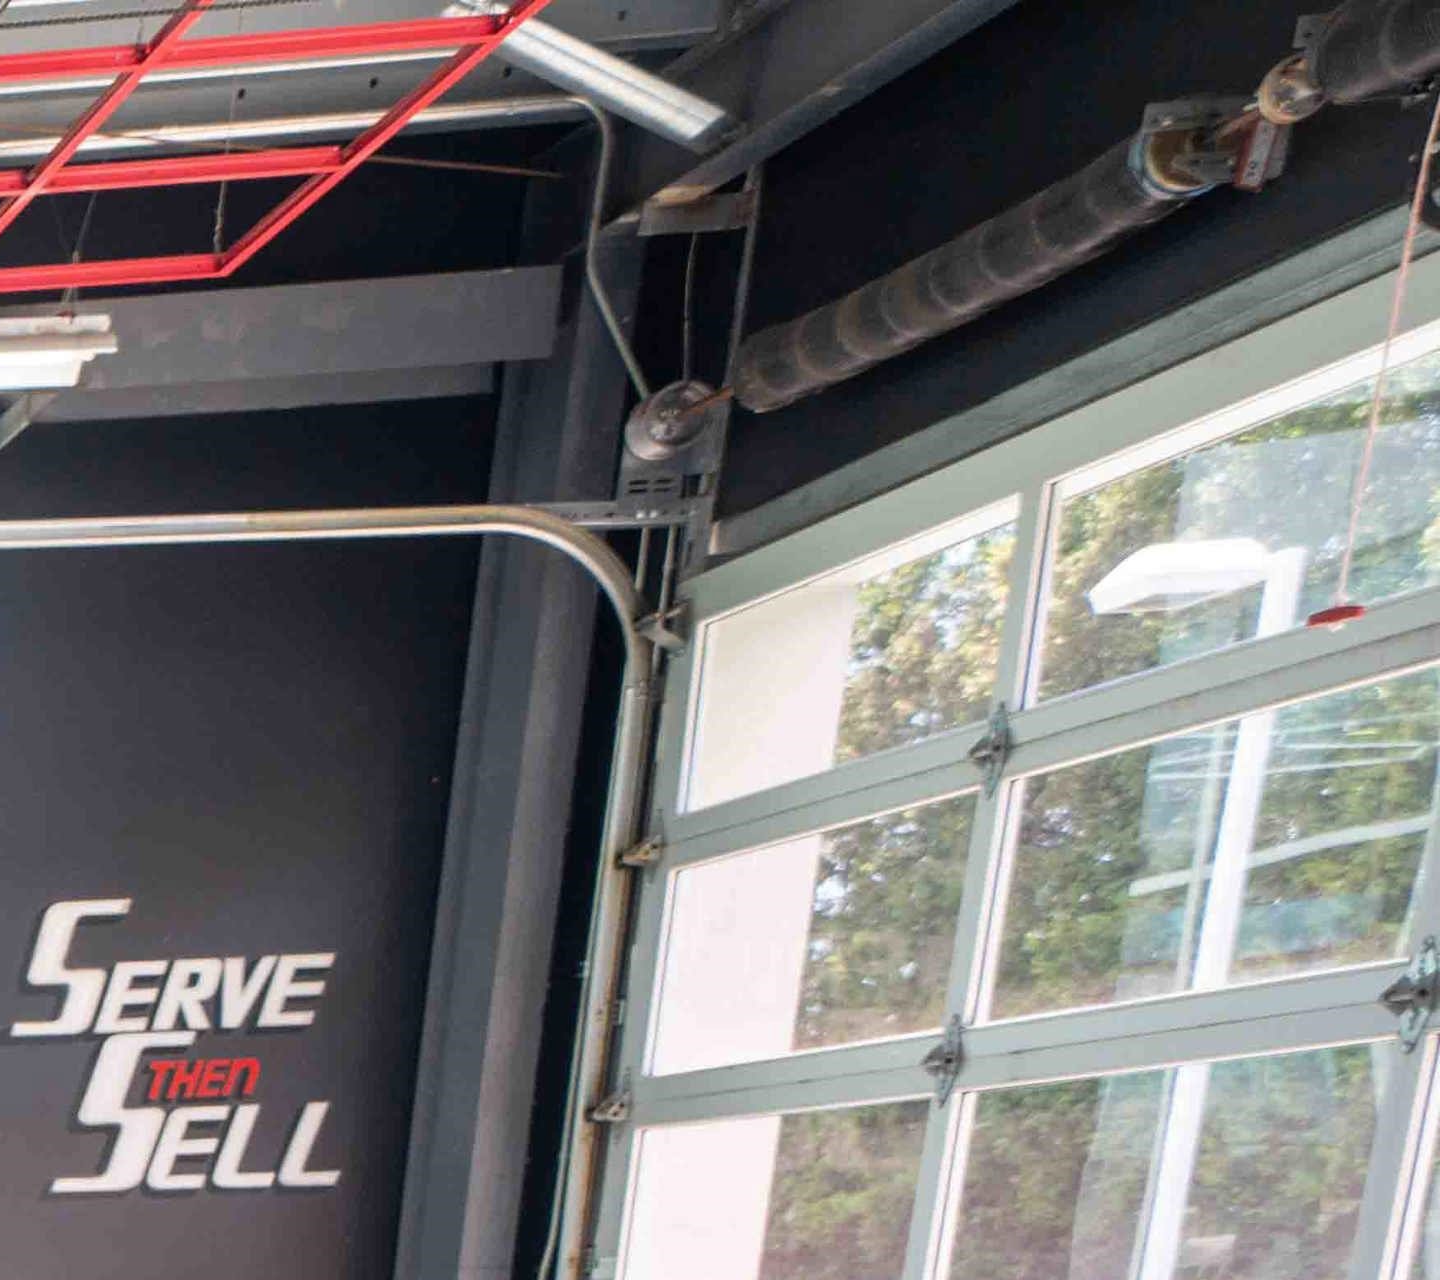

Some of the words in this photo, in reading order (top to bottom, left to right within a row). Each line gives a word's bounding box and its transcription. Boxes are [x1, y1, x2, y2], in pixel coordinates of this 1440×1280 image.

[10, 897, 336, 1037] SERVE
[50, 1031, 342, 1194] SELL
[145, 1057, 260, 1101] THEN
